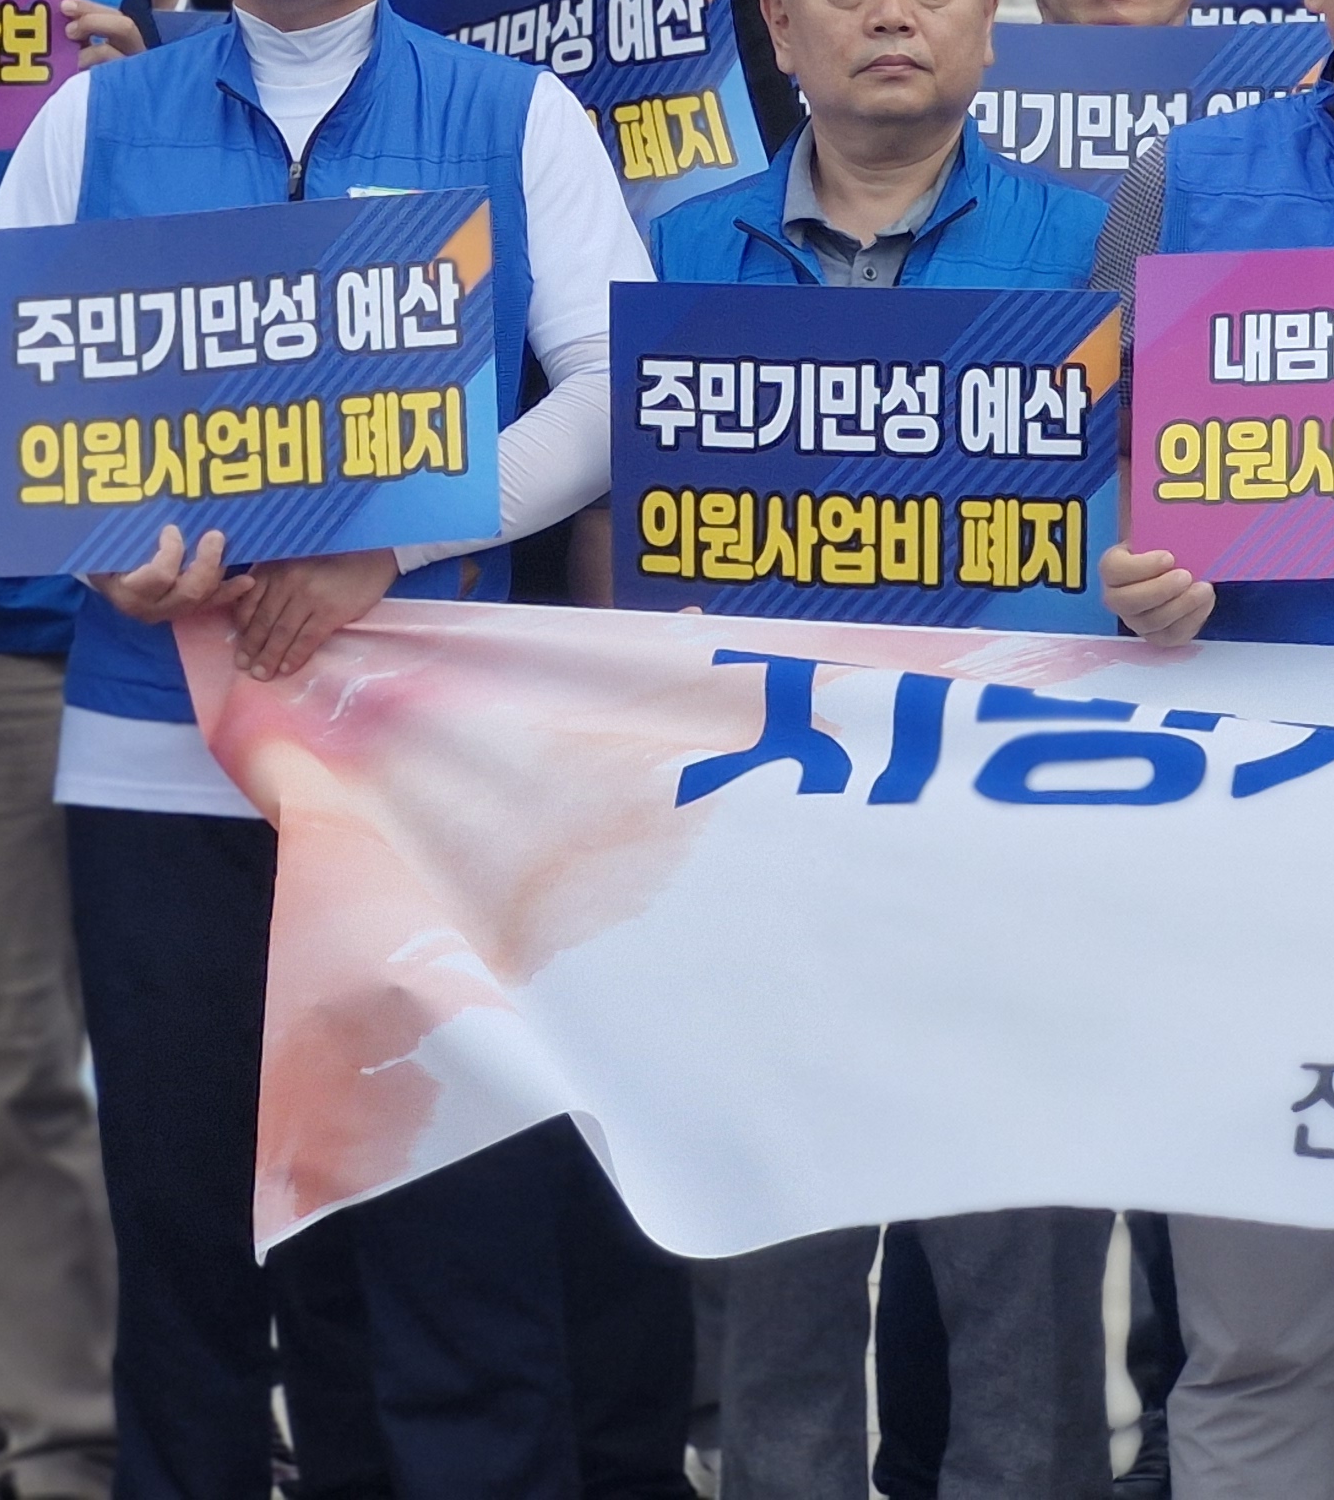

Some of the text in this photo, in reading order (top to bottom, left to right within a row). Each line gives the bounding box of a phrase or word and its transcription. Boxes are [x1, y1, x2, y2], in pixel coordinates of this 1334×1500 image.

[614, 90, 734, 180] 폐지
[17, 262, 462, 382] 주민기만성 예산
[19, 387, 464, 504] 의원사업비 폐지
[639, 360, 1087, 456] 주민기만성 예산
[641, 489, 1082, 589] 의원사업비 폐지
